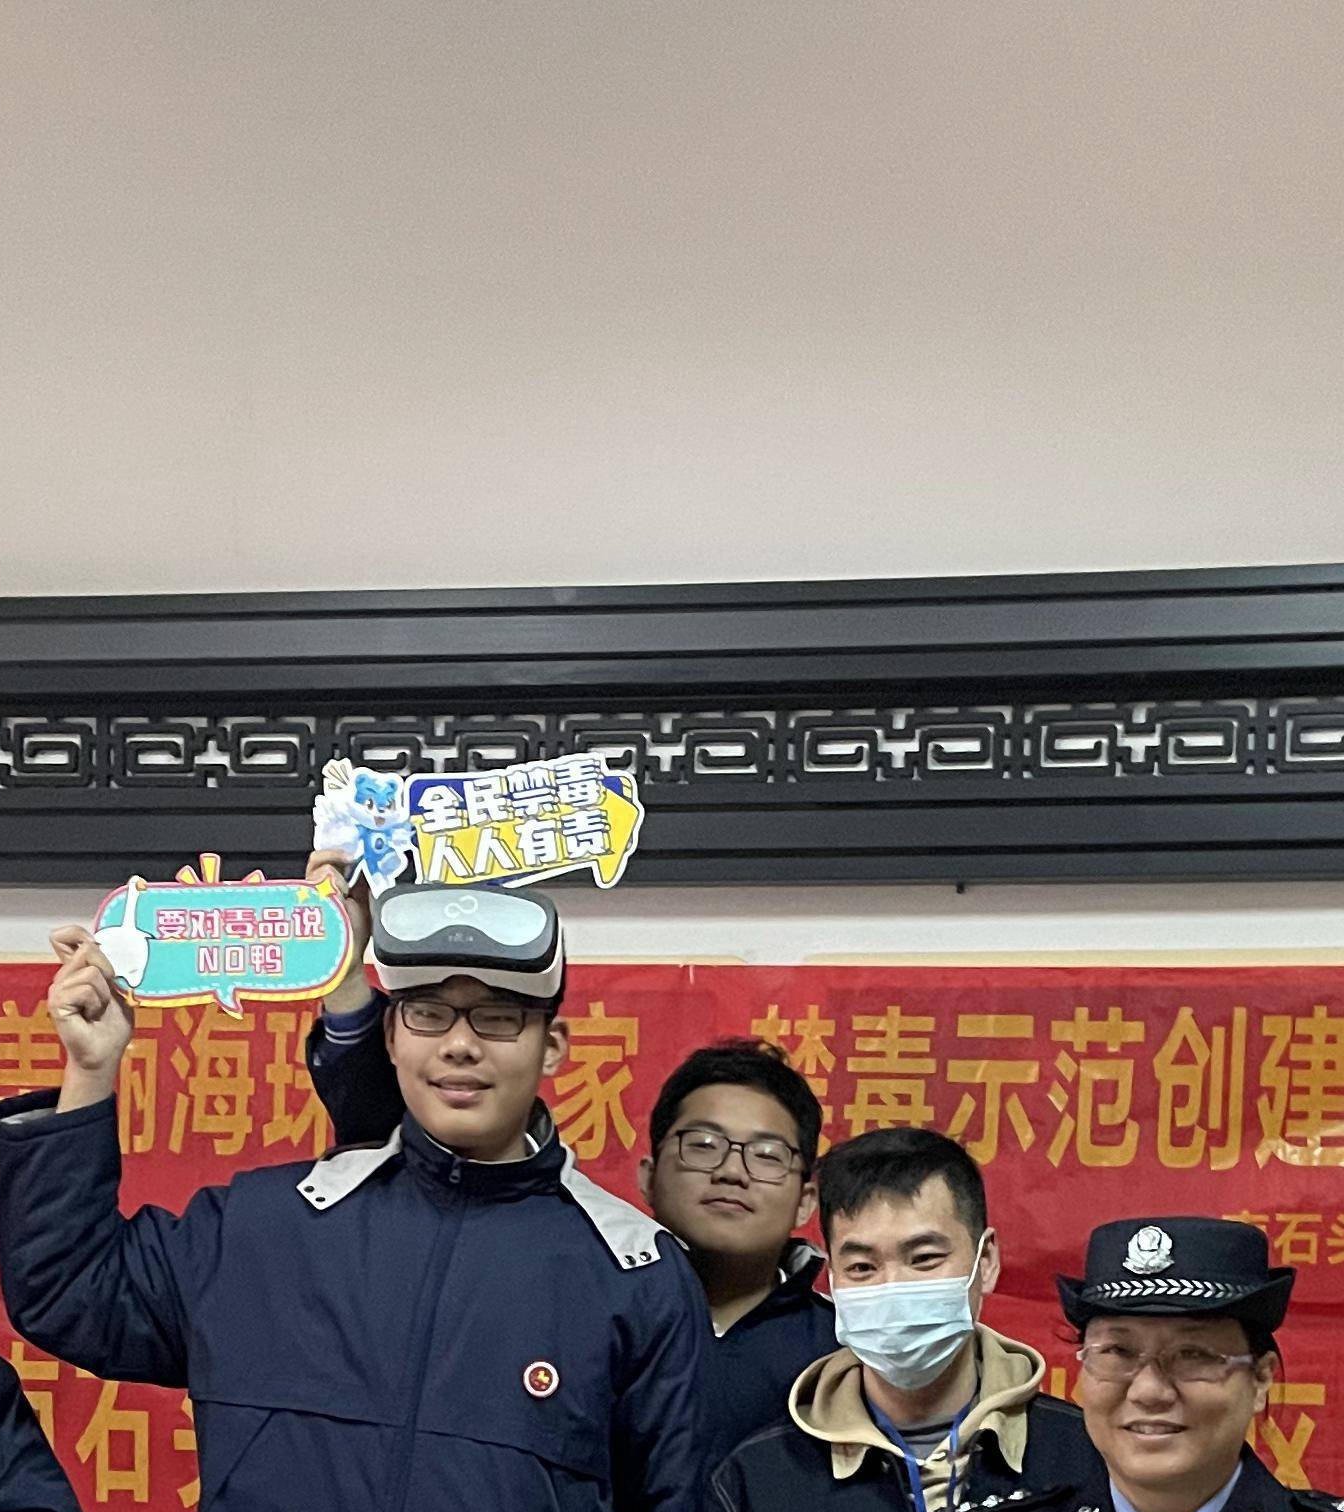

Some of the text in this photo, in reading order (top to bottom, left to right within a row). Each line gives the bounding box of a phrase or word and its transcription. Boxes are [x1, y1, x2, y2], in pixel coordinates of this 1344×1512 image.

[417, 761, 606, 832] 全民禁毒
[424, 809, 612, 882] 人人有责
[156, 906, 324, 940] 要对毒品说
